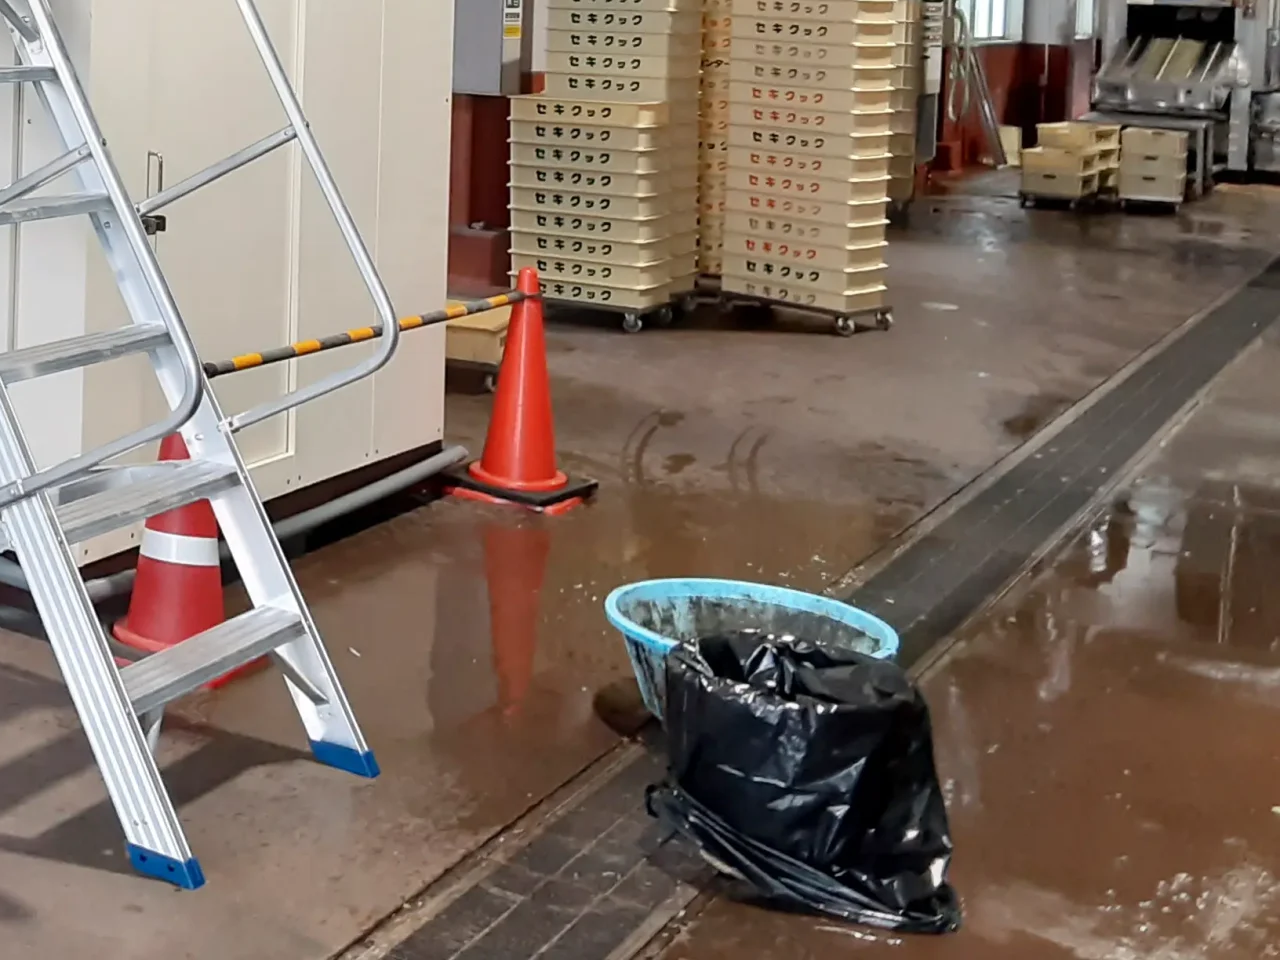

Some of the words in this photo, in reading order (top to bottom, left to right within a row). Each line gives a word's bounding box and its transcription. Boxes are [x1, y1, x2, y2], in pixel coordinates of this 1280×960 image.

[757, 1, 829, 14] セキクック
[571, 13, 642, 25] セキクック
[756, 23, 828, 37] セキクック
[571, 35, 642, 47] セキクック
[569, 56, 641, 69] セキクック
[754, 67, 827, 81] セキクック
[568, 78, 640, 91] セキクック
[752, 88, 824, 104] セキクック
[536, 104, 612, 118] セキクック
[753, 109, 825, 126] セキクック
[535, 126, 611, 141] セキクック
[753, 131, 825, 148] セキクック
[535, 148, 610, 163] セキクック
[750, 153, 822, 171] セキクック
[536, 171, 612, 186] セキクック
[749, 175, 821, 193] セキクック
[535, 193, 610, 209] セキクック
[749, 196, 822, 215] セキクック
[537, 215, 612, 232] セキクック
[537, 238, 612, 255] セキクック
[745, 239, 817, 260] セキクック
[537, 260, 612, 278] セキクック
[746, 260, 820, 282] セキクック
[539, 283, 612, 300] セキクック
